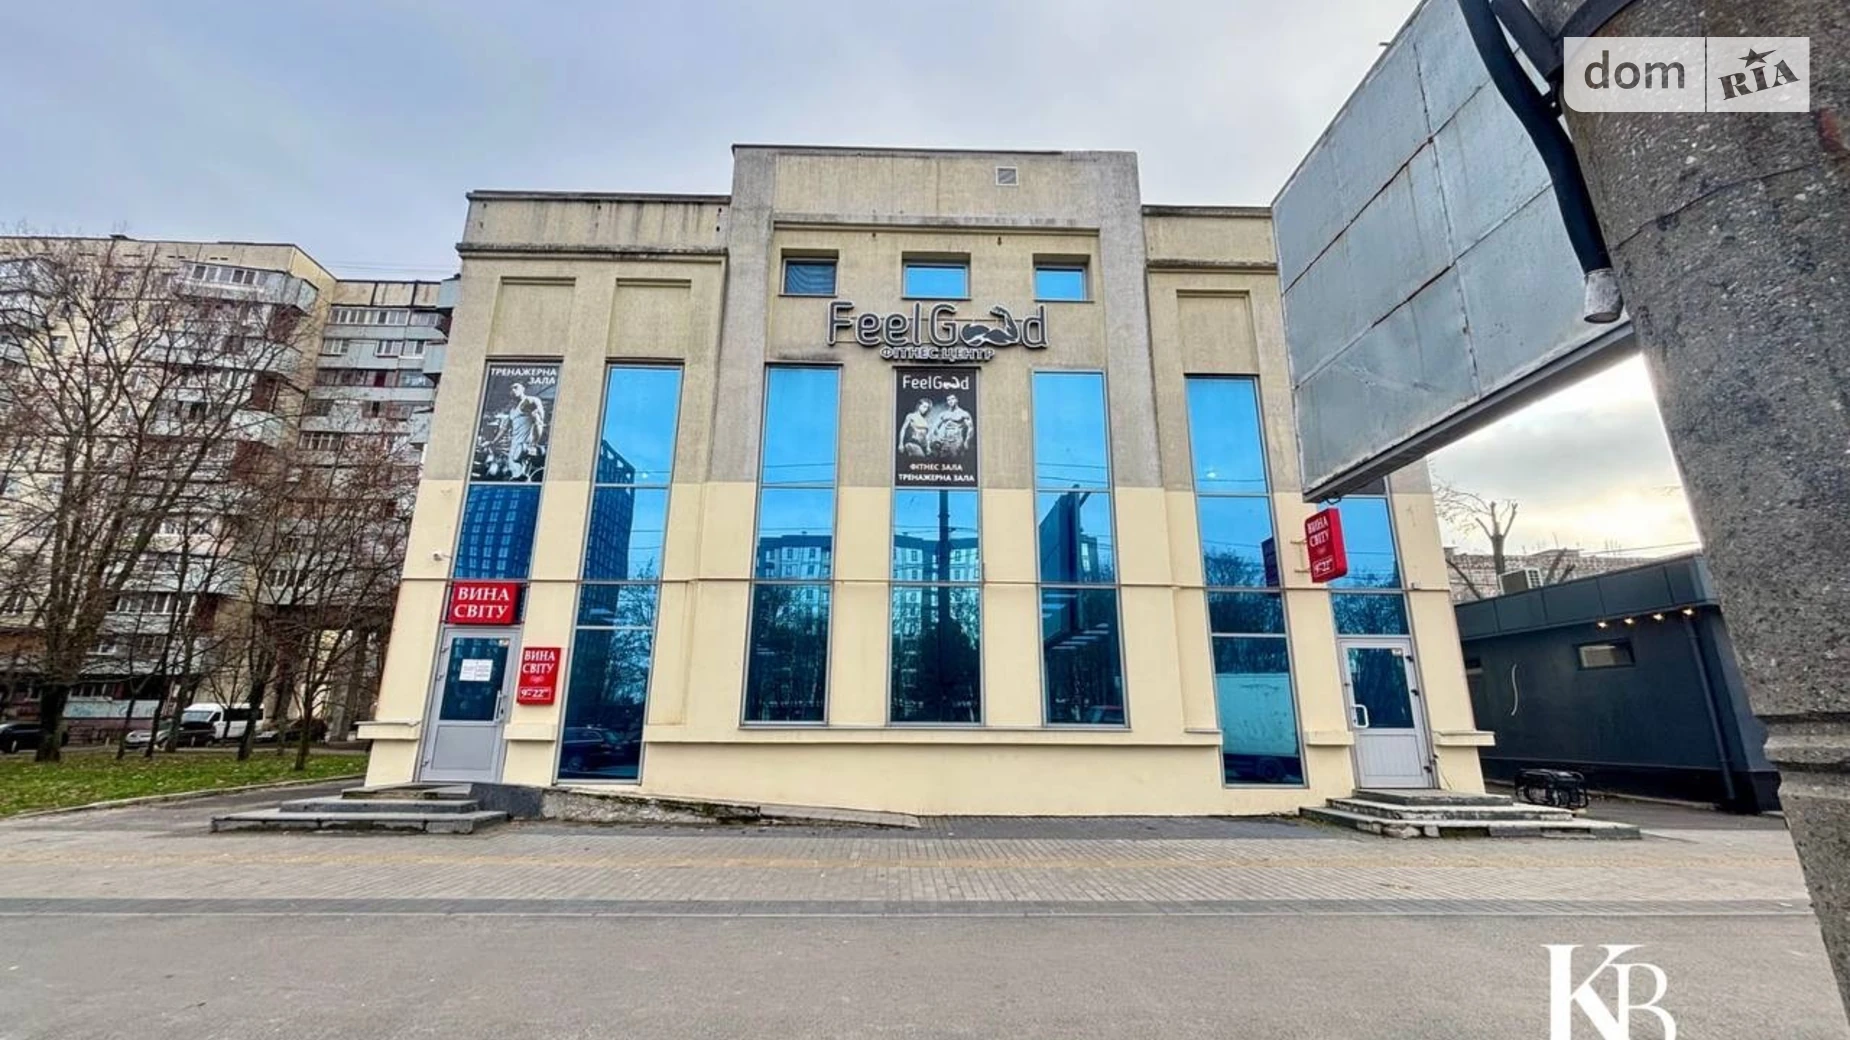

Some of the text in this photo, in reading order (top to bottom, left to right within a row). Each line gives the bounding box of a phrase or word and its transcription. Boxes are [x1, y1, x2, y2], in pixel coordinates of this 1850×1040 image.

[880, 346, 996, 362] ФІТНЕС ЦЕНТР
[490, 367, 557, 376] ТРЕНАЖЕРНА
[528, 376, 556, 385] ЗАЛА
[941, 463, 963, 471] ЗАЛА
[953, 474, 975, 482] ЗАЛА
[457, 586, 510, 601] ВИНА
[454, 604, 509, 618] СВІТУ
[524, 650, 555, 661] ВИНА
[522, 662, 556, 674] СВІТУ
